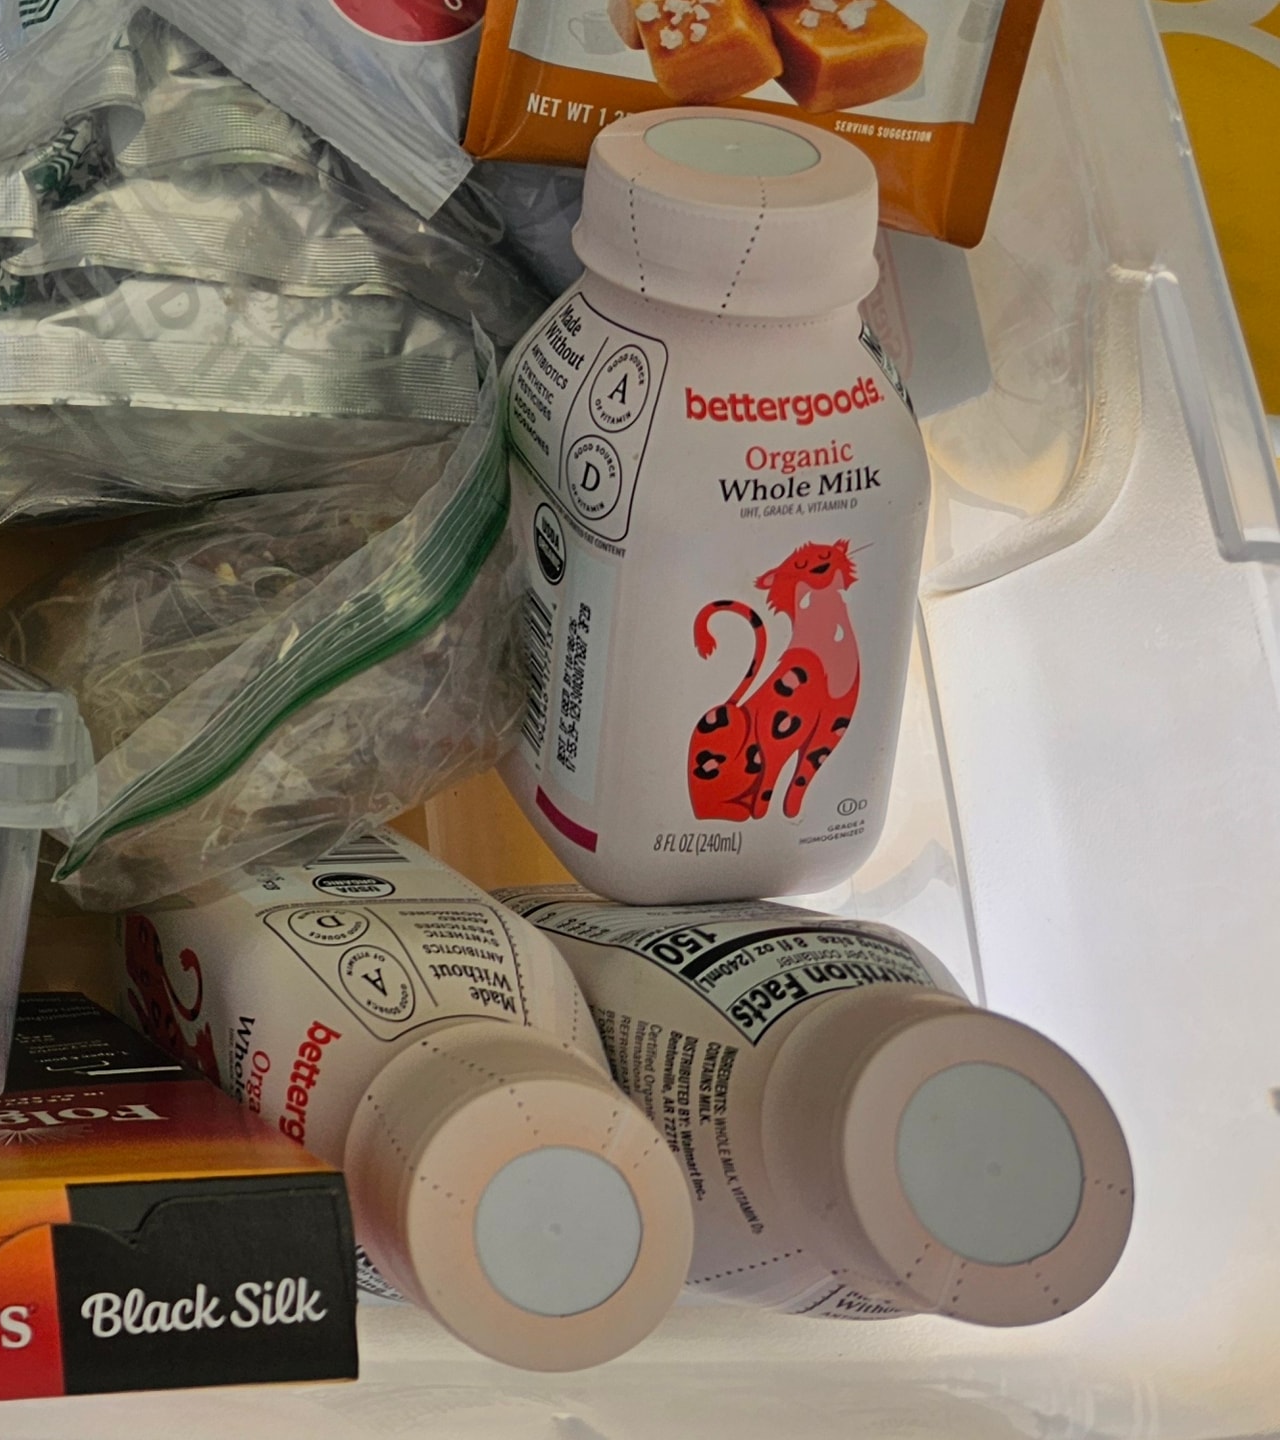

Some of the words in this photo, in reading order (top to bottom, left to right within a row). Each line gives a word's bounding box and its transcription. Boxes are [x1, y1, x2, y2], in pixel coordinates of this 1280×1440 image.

[834, 120, 875, 138] SERVING
[876, 124, 934, 144] SUGGESTION
[558, 303, 582, 338] Made
[543, 320, 586, 372] Without
[684, 375, 882, 427] bettergoods
[744, 438, 855, 475] Organic
[718, 469, 811, 504] Whole
[818, 464, 881, 495] Milk
[650, 927, 721, 966] 150
[361, 967, 389, 998] A
[428, 963, 514, 993] Without
[469, 985, 517, 1015] Made
[80, 1284, 226, 1340] Black
[230, 1275, 330, 1330] Silk
